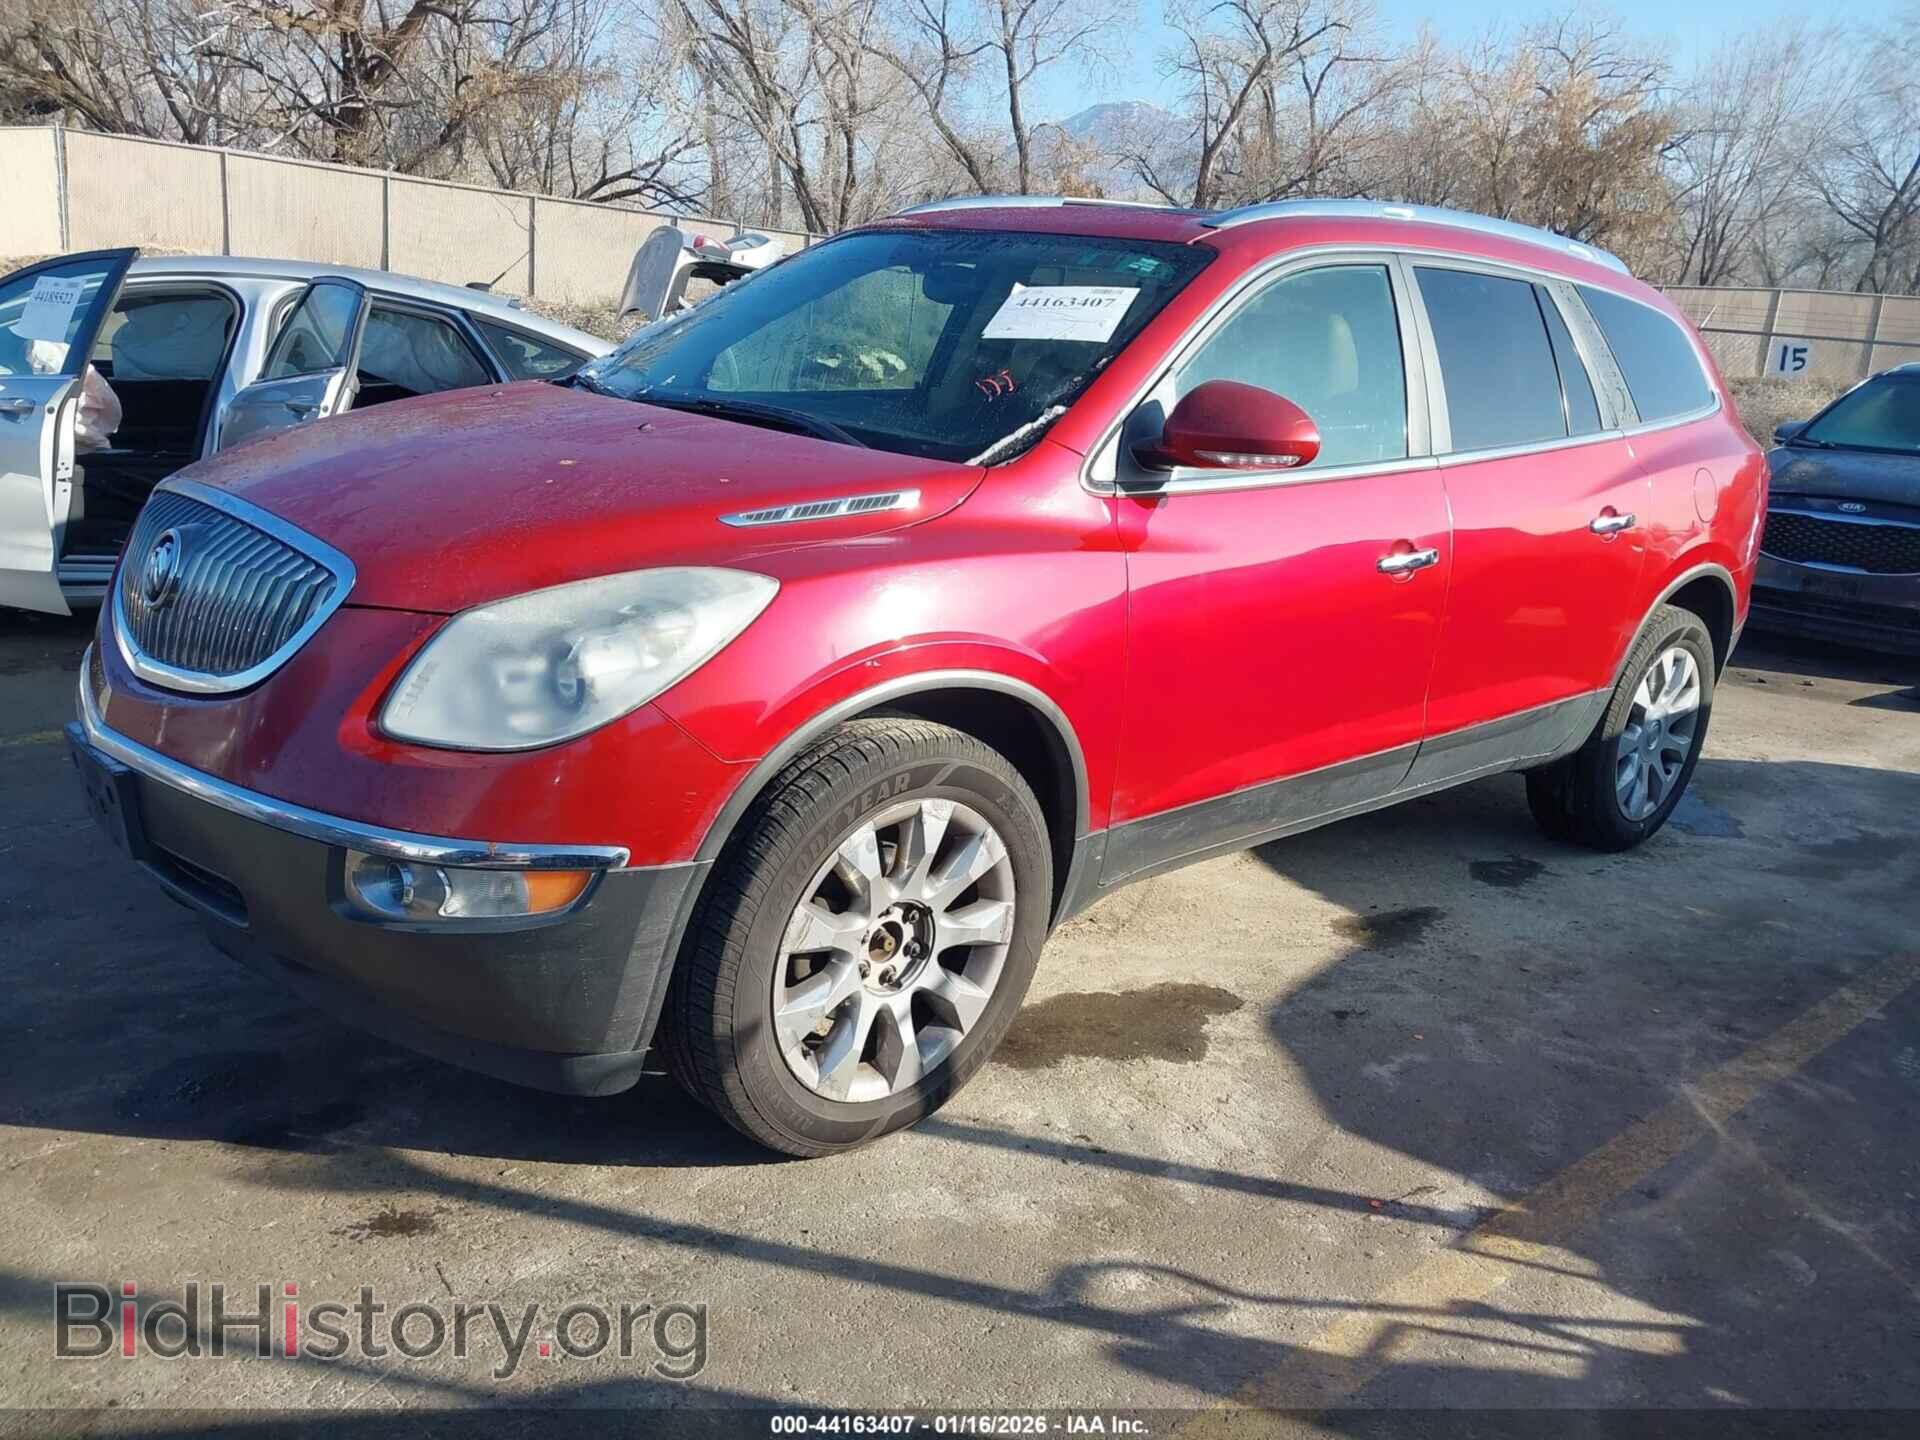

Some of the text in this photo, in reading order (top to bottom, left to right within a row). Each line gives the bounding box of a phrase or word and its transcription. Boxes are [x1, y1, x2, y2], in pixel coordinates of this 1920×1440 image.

[1015, 297, 1117, 307] 44163407
[1780, 345, 1808, 371] 15
[769, 773, 912, 905] GOODYEAR
